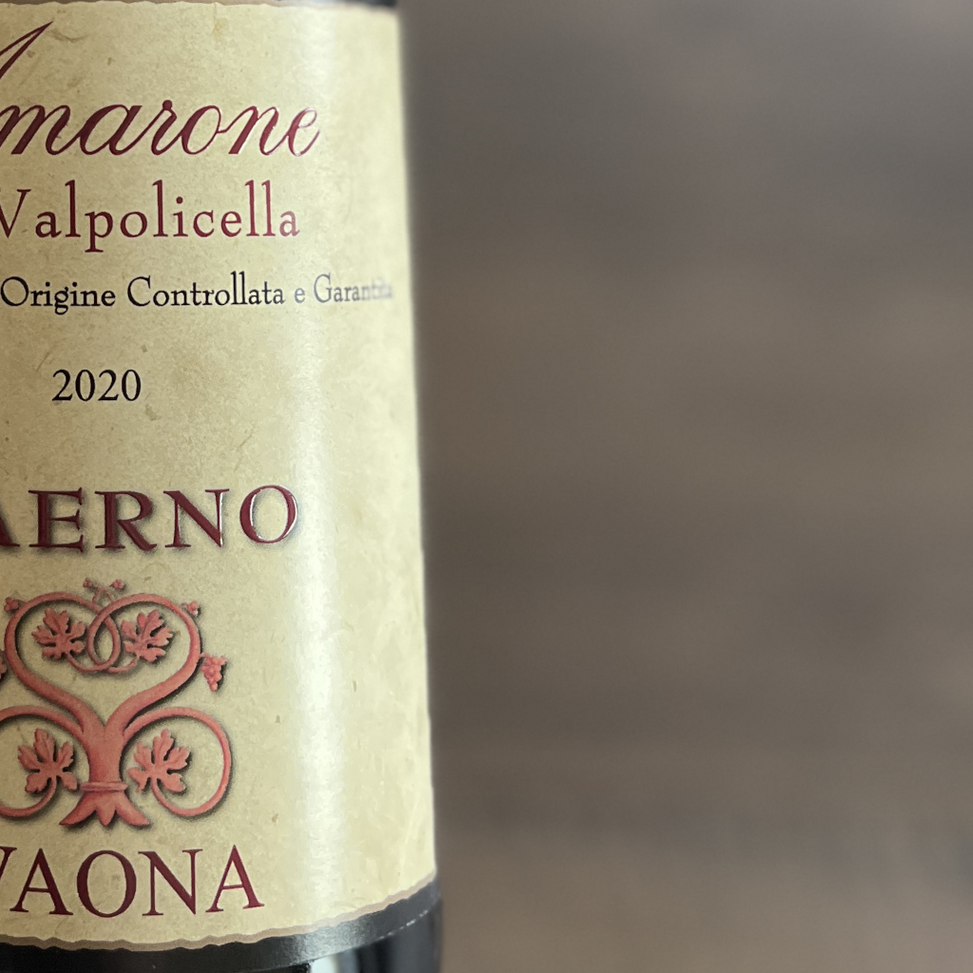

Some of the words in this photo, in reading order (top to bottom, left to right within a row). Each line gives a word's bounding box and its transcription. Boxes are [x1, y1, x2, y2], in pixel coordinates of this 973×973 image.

[0, 275, 116, 316] Origine
[127, 270, 286, 307] Controllata
[293, 286, 307, 305] e
[52, 368, 142, 403] 2020
